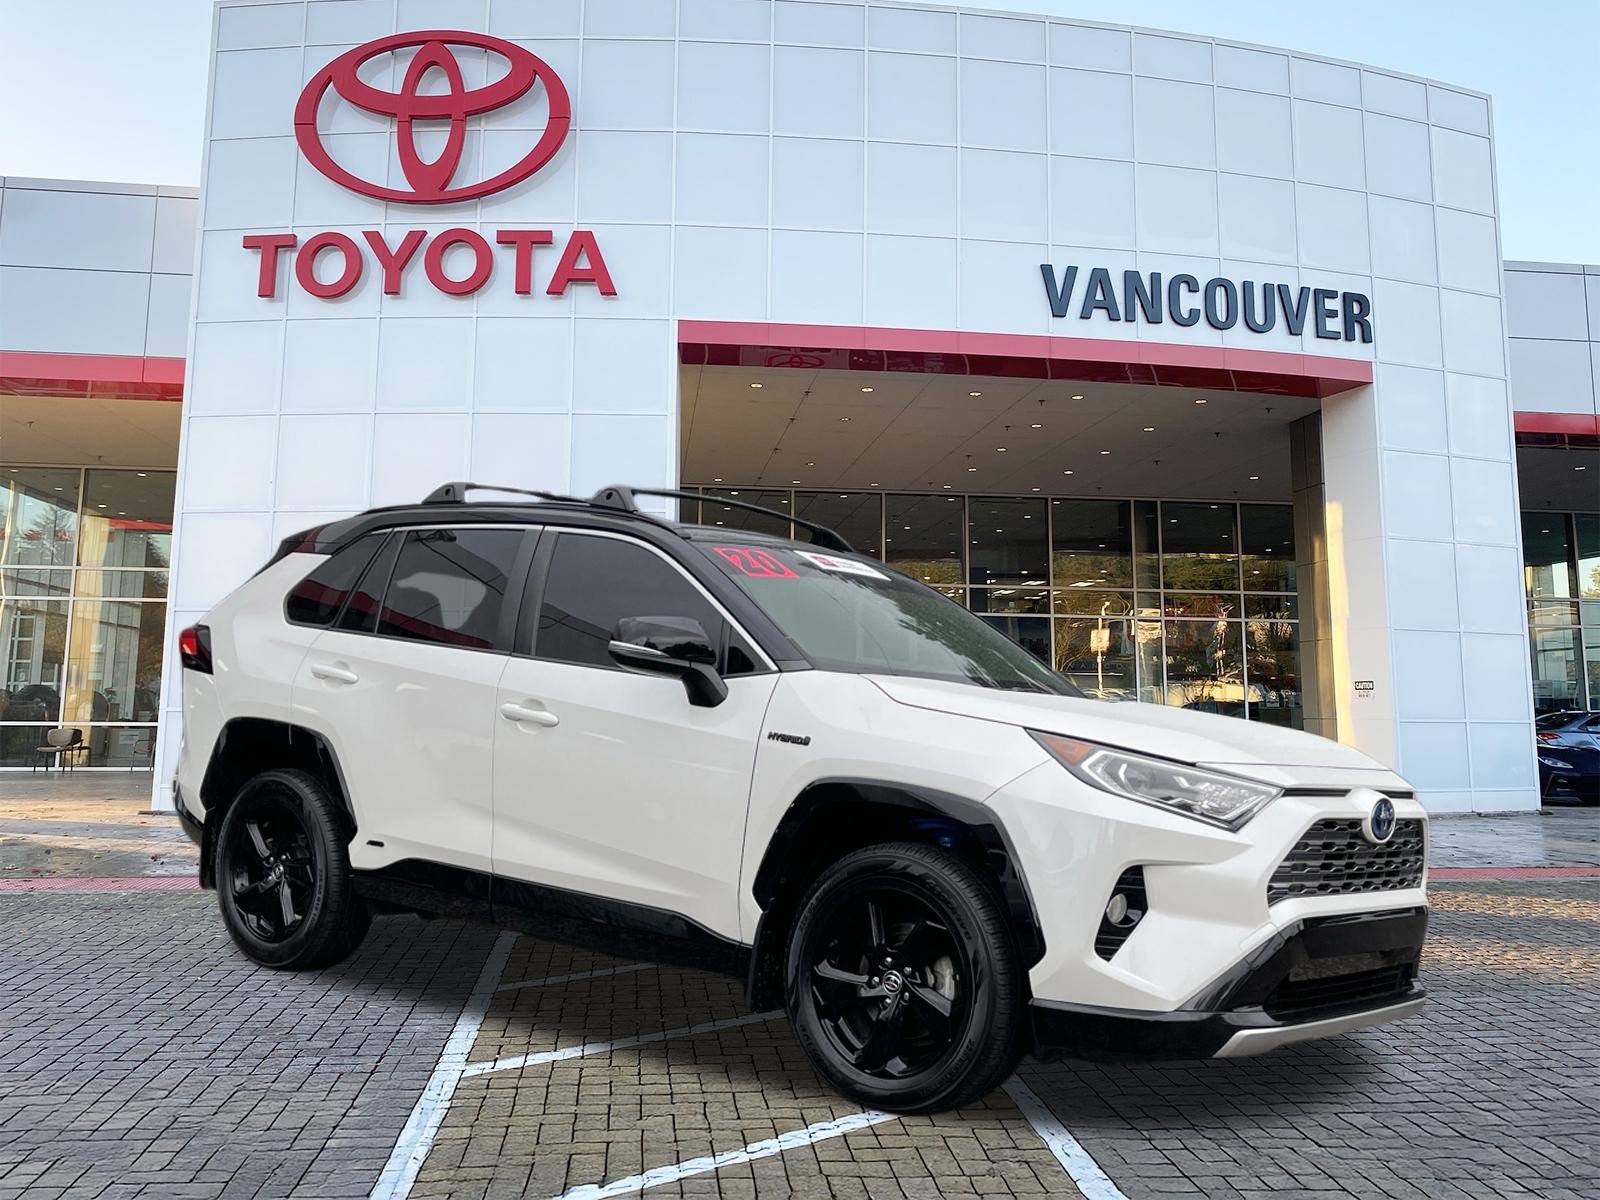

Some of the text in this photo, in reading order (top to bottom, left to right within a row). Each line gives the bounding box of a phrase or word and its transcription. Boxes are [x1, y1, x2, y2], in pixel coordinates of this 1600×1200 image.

[243, 229, 618, 299] TOYOTA
[1040, 263, 1374, 344] VANCOUVER
[768, 731, 803, 745] HYBRID
